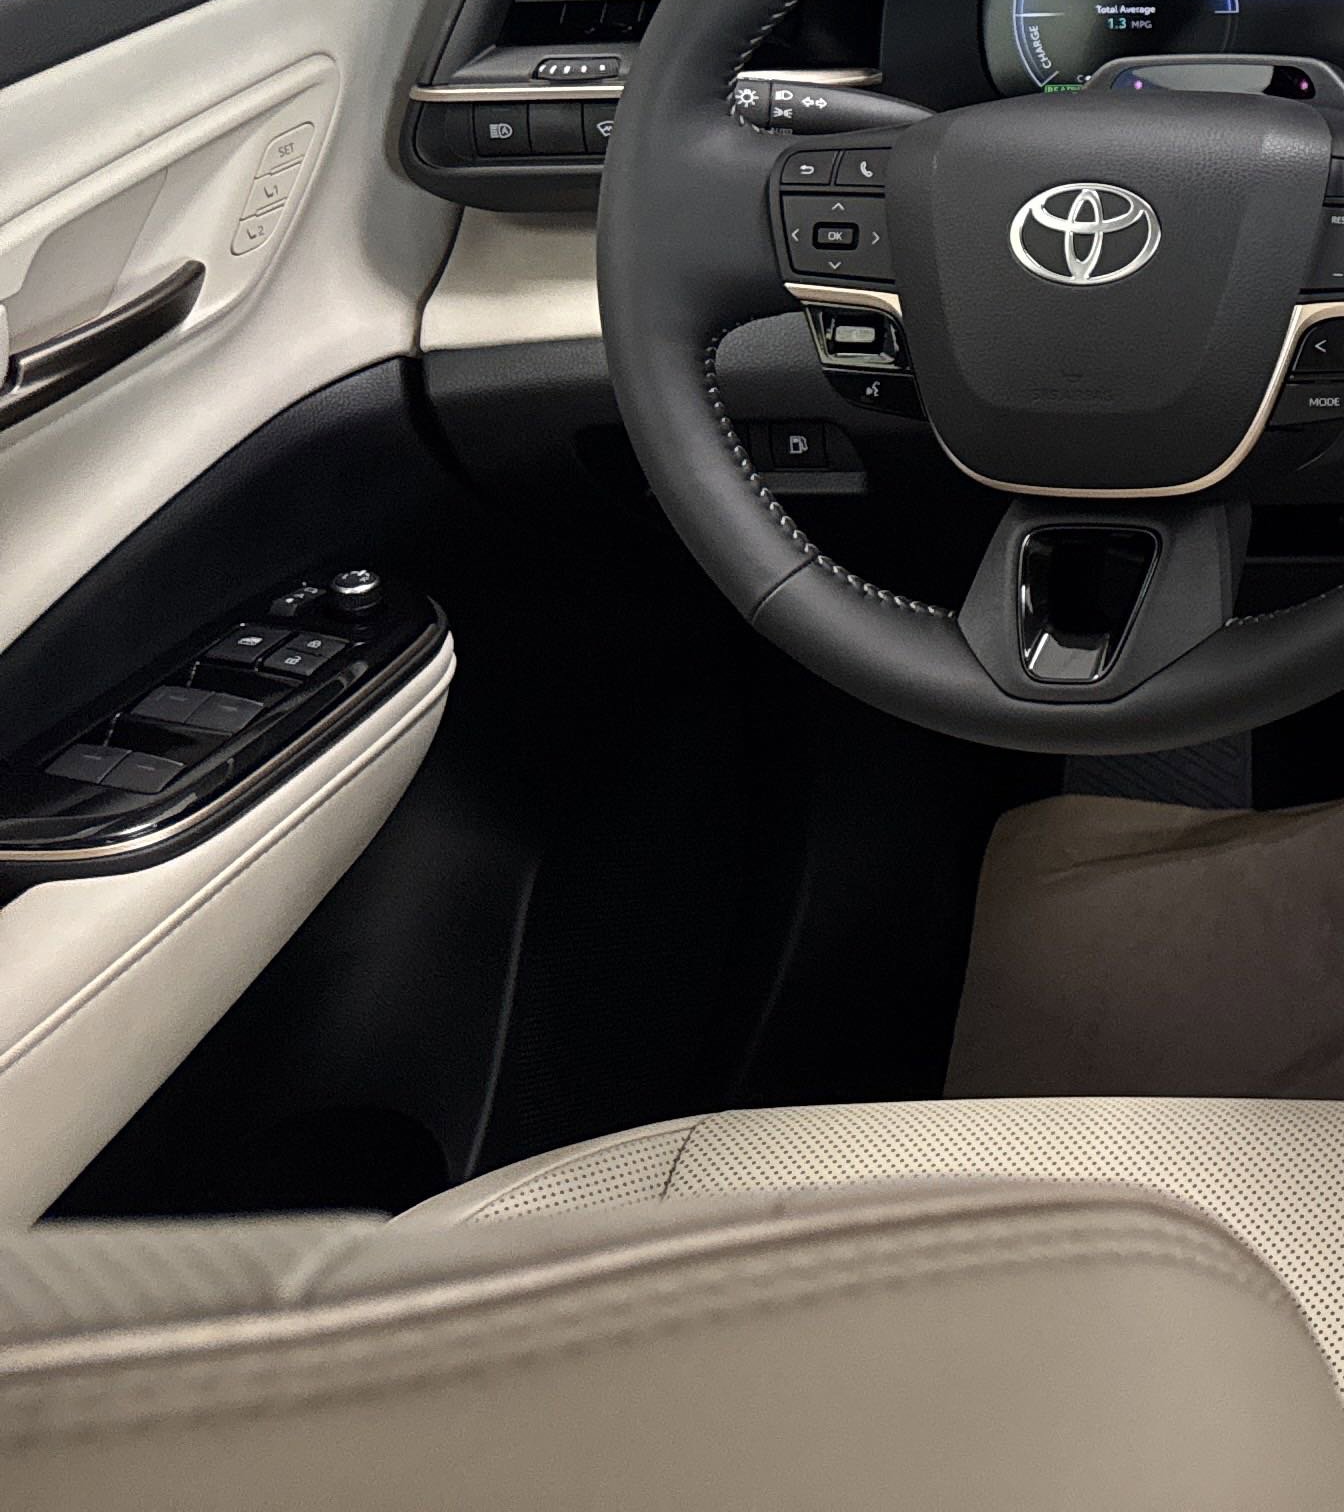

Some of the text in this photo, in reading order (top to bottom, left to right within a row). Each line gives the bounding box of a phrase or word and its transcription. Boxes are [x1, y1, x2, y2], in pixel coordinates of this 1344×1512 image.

[1096, 4, 1157, 15] Total Average
[1107, 18, 1153, 30] 1.3 MPG
[1028, 25, 1053, 69] CHARGE
[278, 143, 295, 158] SET
[827, 231, 843, 241] OK
[1309, 397, 1340, 407] MODE
